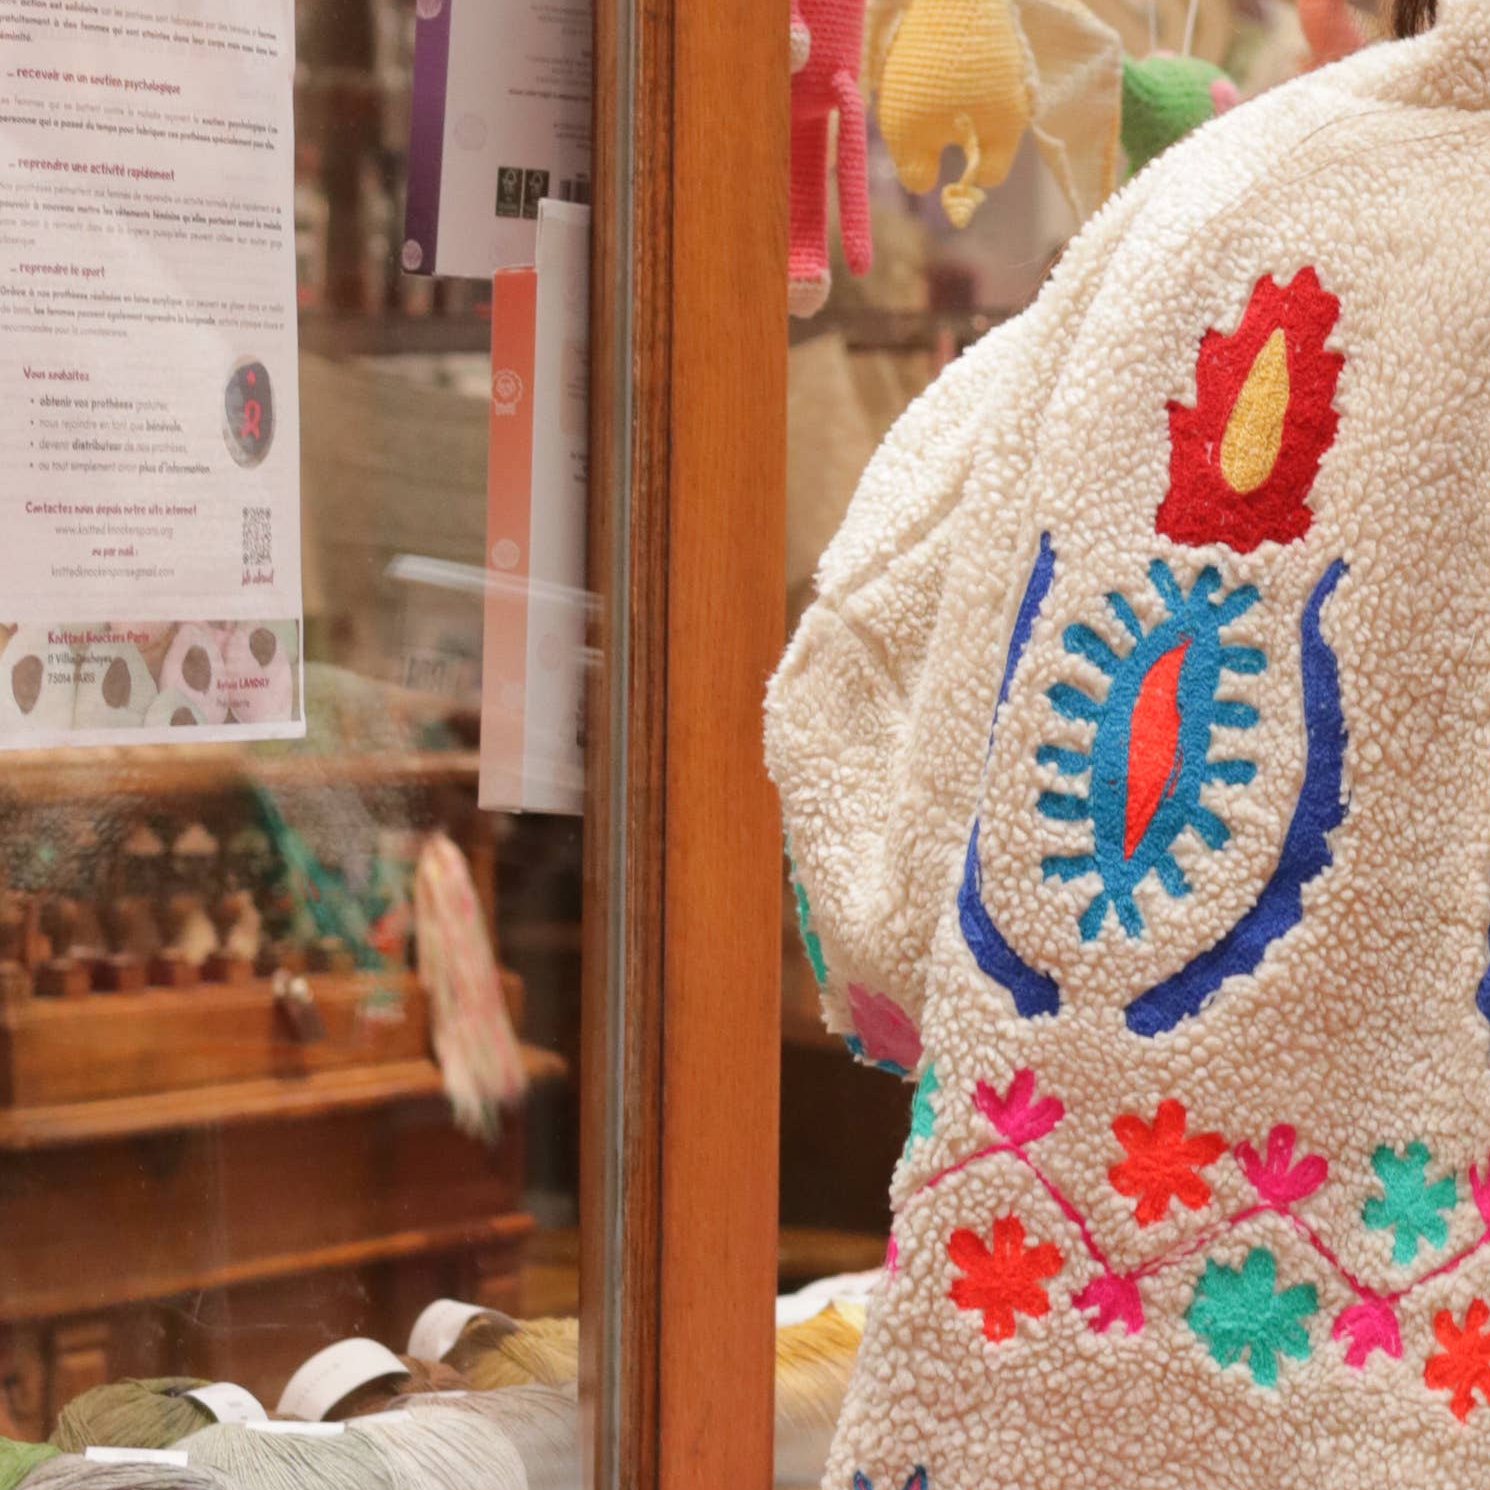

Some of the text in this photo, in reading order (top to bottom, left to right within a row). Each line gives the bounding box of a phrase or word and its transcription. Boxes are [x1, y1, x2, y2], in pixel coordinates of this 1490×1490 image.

[16, 68, 60, 82] recevoir
[62, 72, 74, 83] un
[18, 157, 69, 173] reprendre
[71, 162, 88, 174] une
[19, 262, 69, 277] reprendre
[22, 364, 46, 380] Vous
[39, 394, 72, 408] obtenir
[48, 630, 84, 644] Knitted
